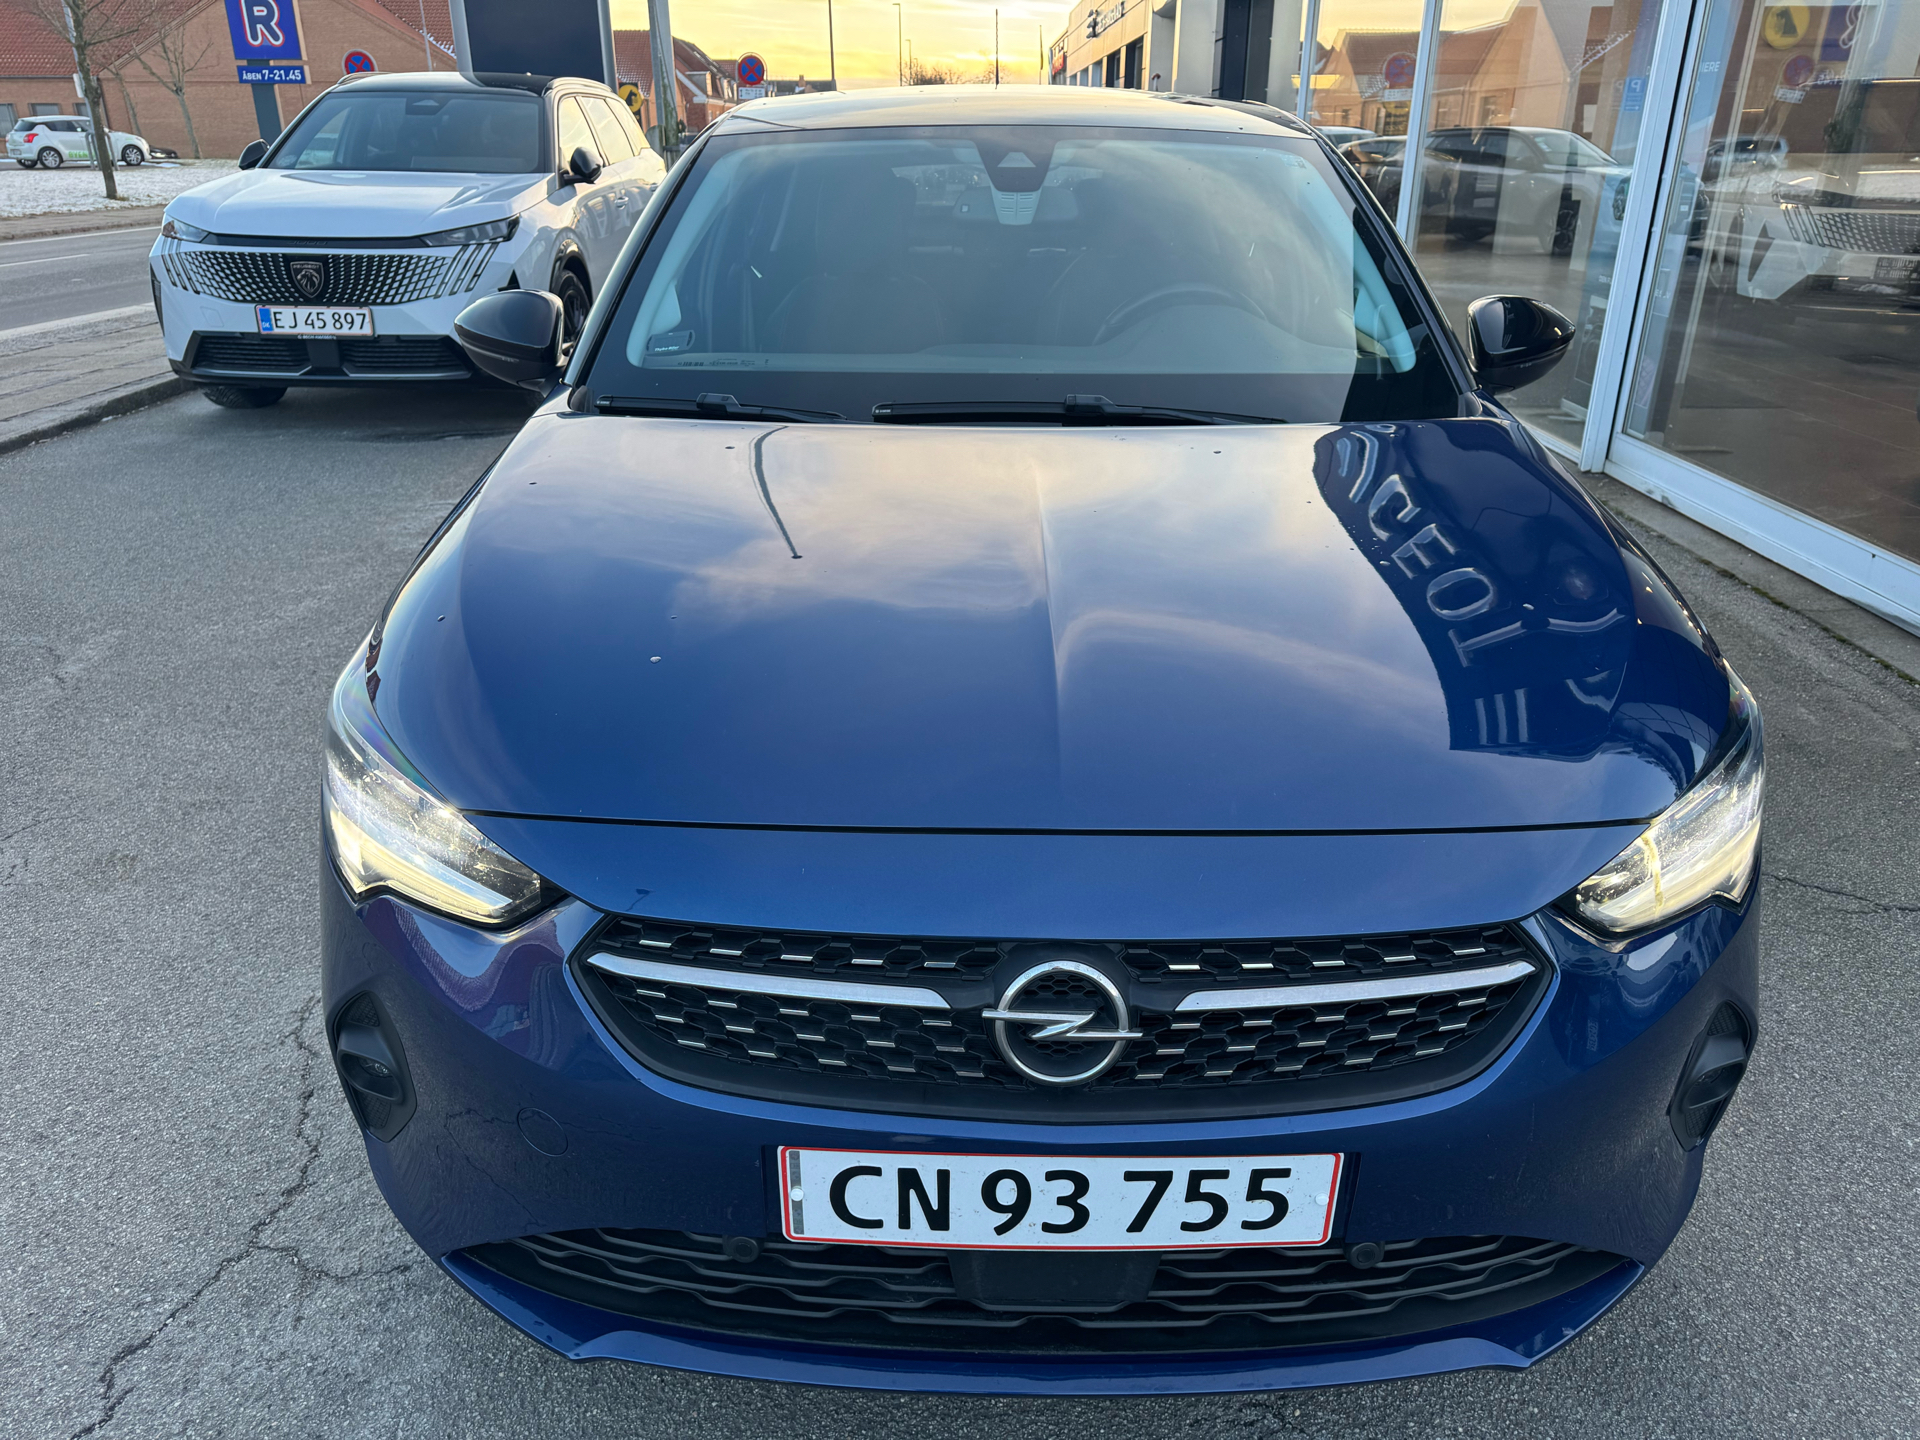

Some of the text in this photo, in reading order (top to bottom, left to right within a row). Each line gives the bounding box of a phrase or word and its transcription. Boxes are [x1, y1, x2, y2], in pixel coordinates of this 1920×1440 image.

[239, 0, 285, 47] R
[242, 69, 302, 80] ÅBEN 7-21.45
[272, 311, 367, 331] EJ 45 897
[829, 1165, 950, 1232] CN
[980, 1169, 1091, 1236] 93
[1123, 1167, 1292, 1234] 755
